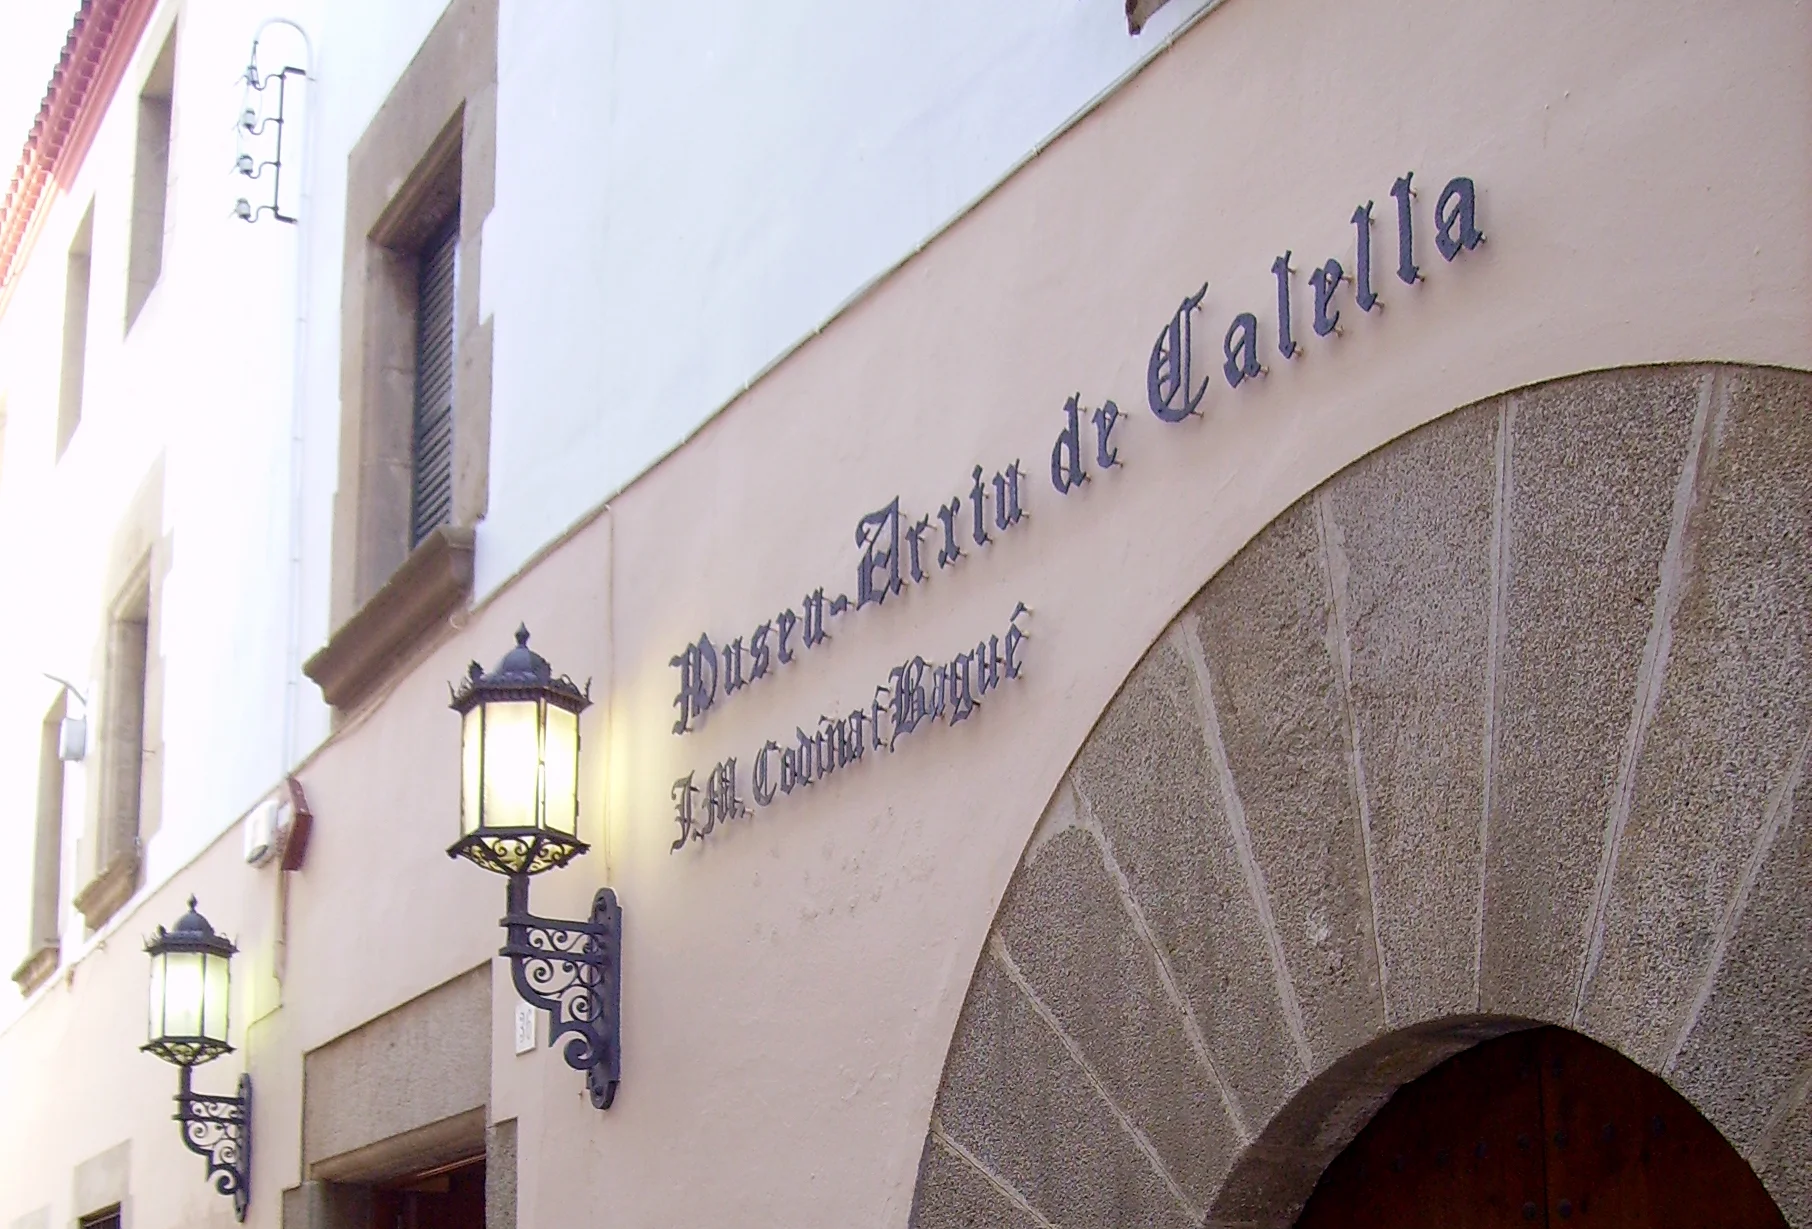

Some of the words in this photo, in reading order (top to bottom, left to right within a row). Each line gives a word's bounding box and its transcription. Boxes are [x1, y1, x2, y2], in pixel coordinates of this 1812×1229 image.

[1051, 391, 1119, 495] de
[1147, 171, 1484, 423] Calella
[751, 707, 865, 807] Codina
[888, 601, 1028, 753] Bagué
